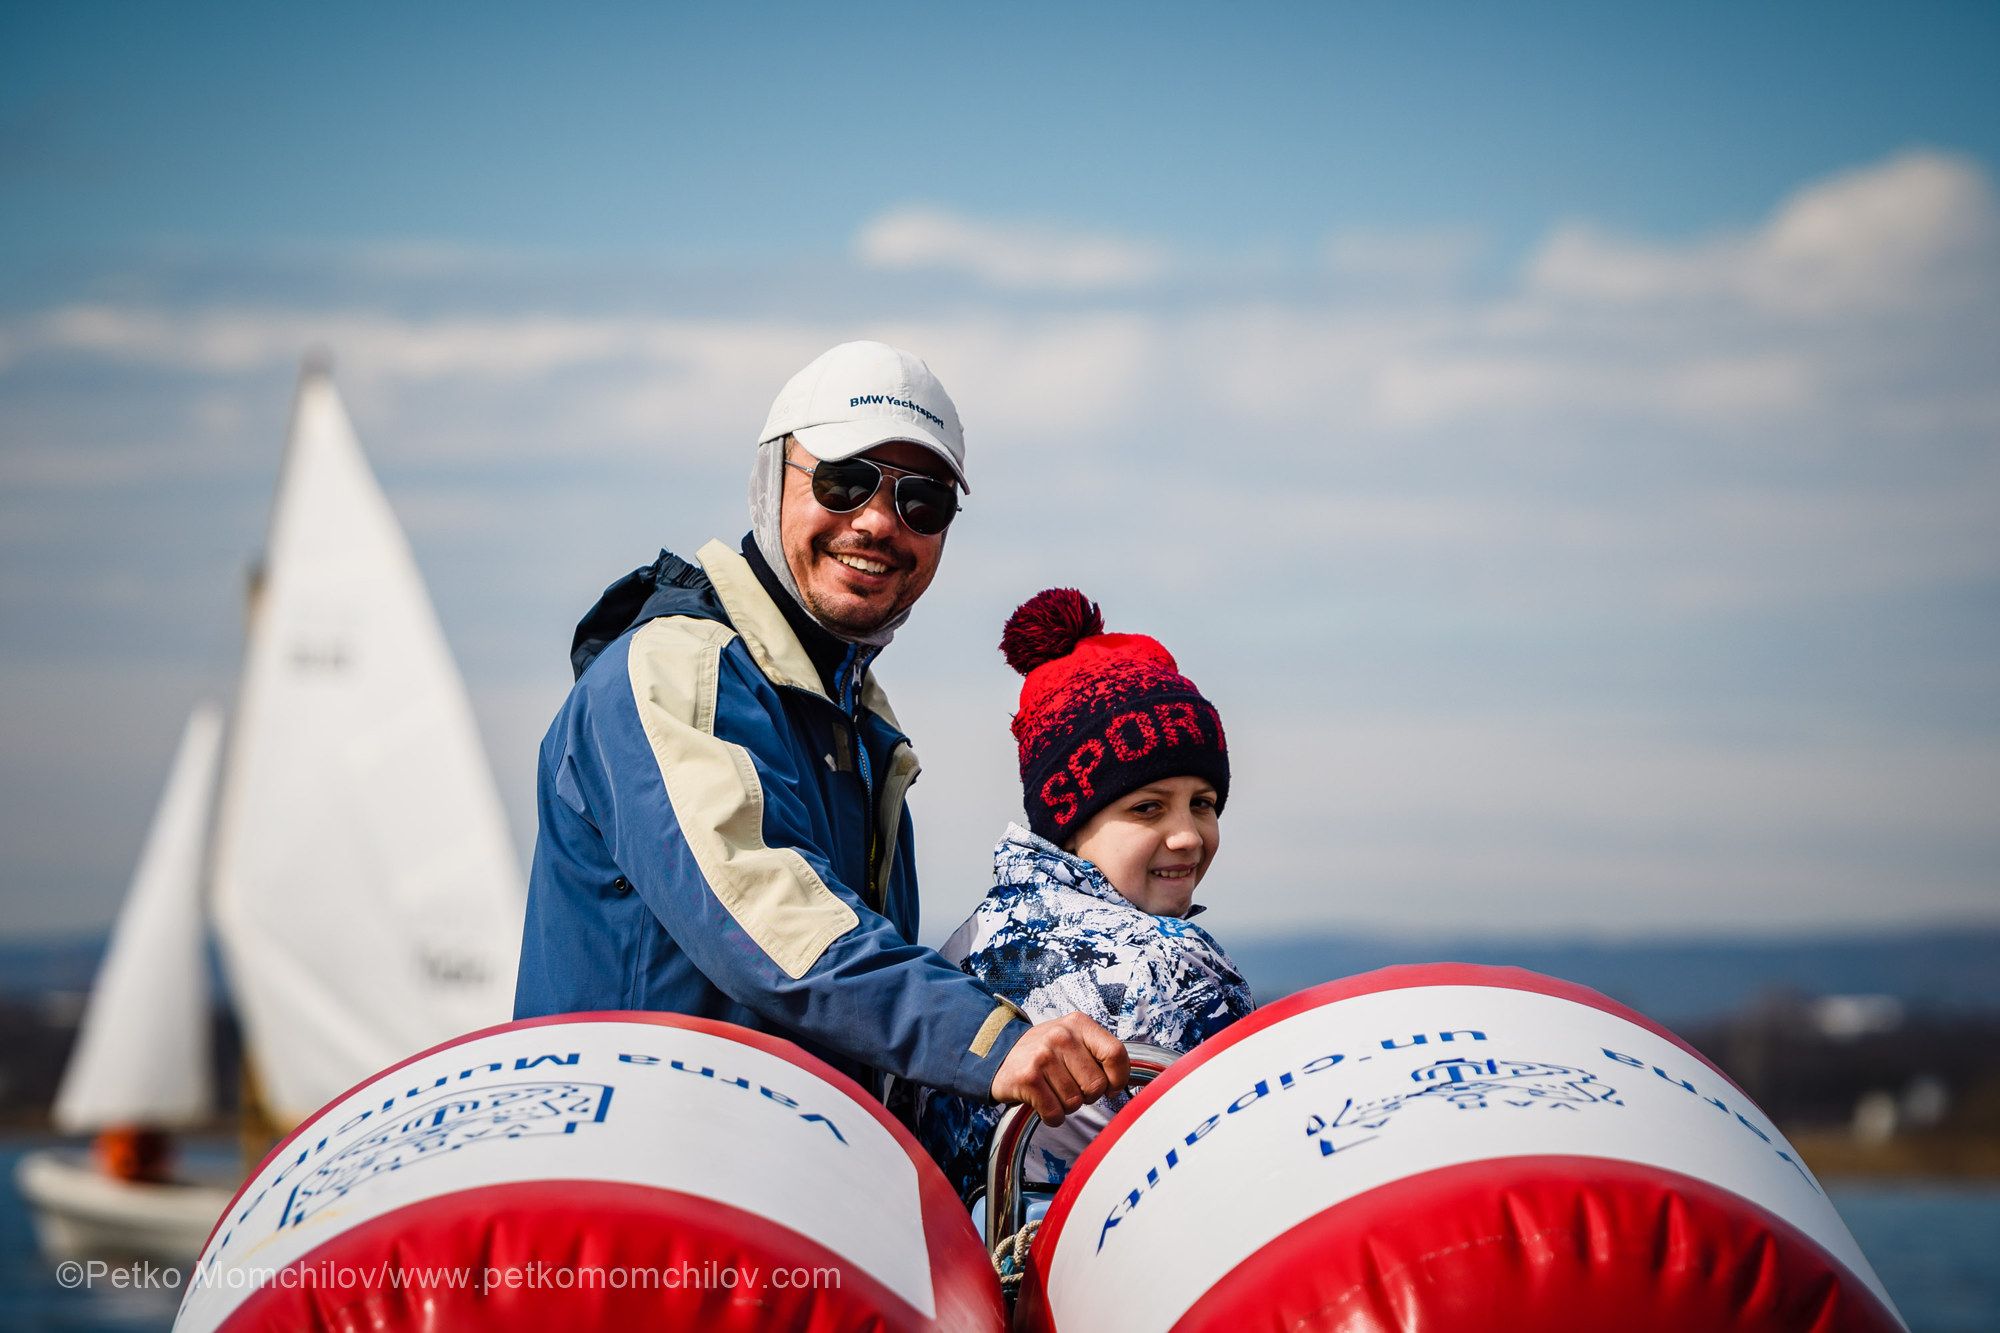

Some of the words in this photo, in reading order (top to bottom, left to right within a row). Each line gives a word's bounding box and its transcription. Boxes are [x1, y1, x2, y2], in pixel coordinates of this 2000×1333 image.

[850, 395, 884, 408] BMW
[886, 396, 945, 430] Yachtsport
[617, 1051, 850, 1147] Varna
